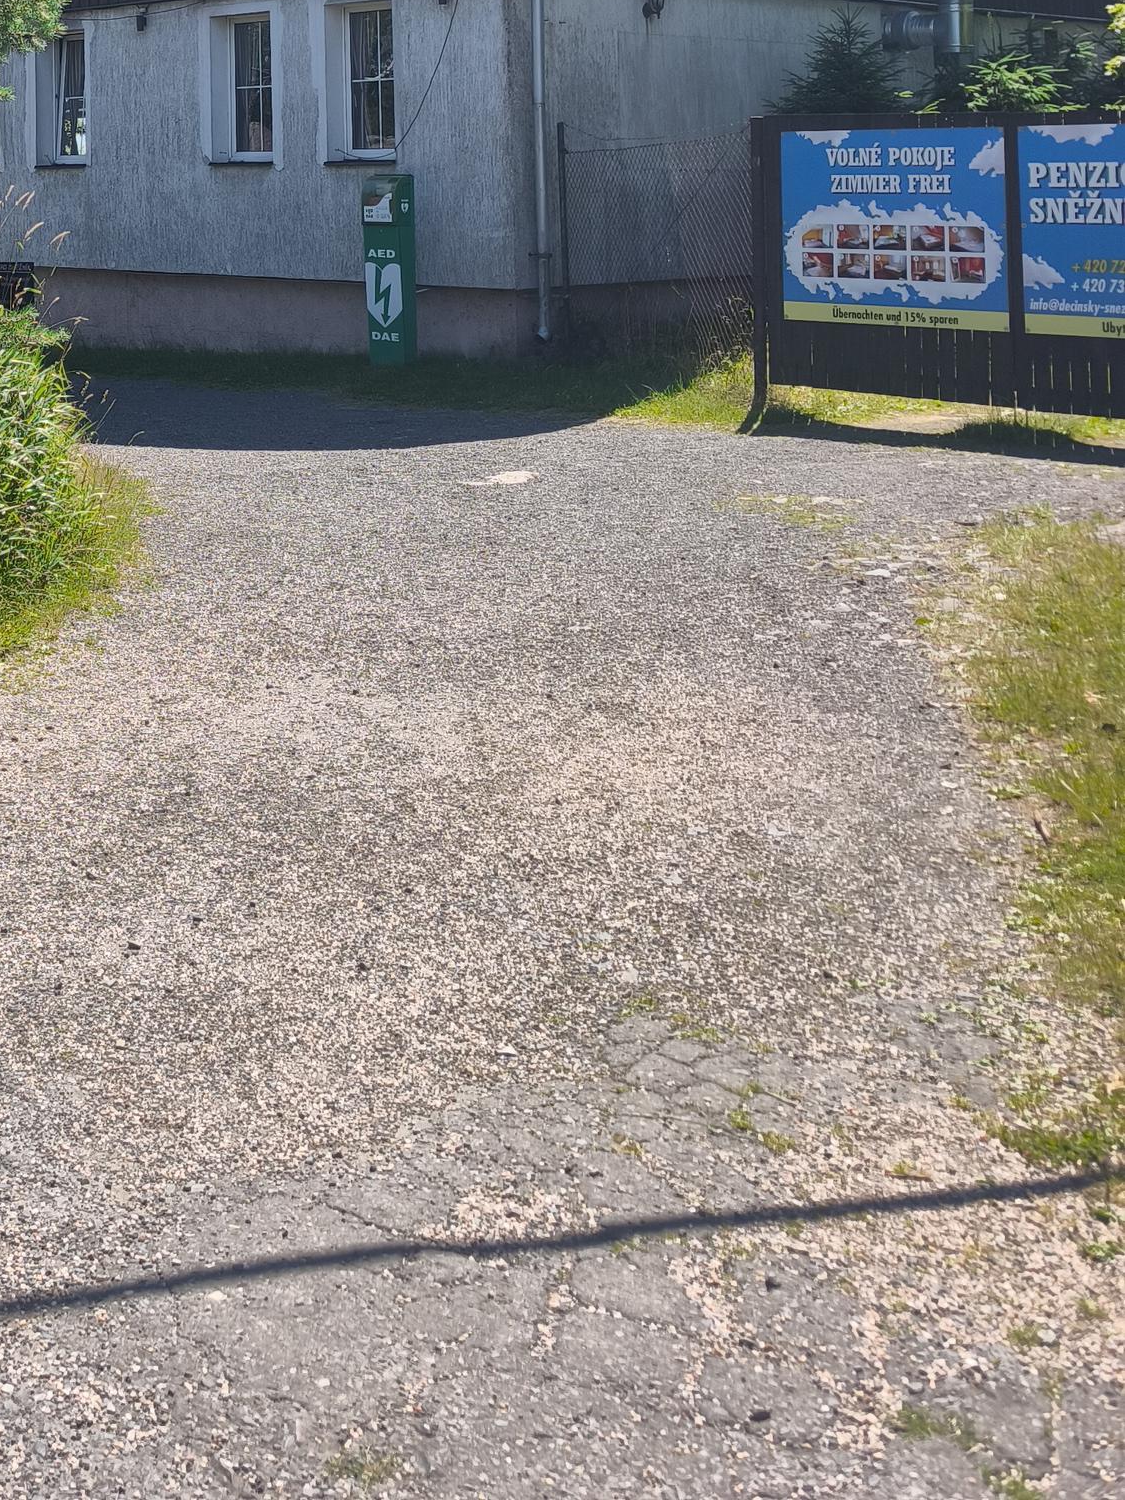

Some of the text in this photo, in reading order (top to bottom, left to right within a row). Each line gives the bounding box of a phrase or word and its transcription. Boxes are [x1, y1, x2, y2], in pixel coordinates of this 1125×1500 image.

[826, 142, 955, 171] VOLNÉ POKOJE
[830, 174, 953, 194] ZIMMER FREI
[1029, 190, 1125, 225] SNĚŽN
[367, 248, 396, 259] AED
[1083, 259, 1108, 274] 420
[1082, 278, 1107, 293] 420
[1108, 279, 1125, 294] 73
[832, 308, 959, 327] Übernachten und 15% sparen
[371, 331, 400, 342] DAE
